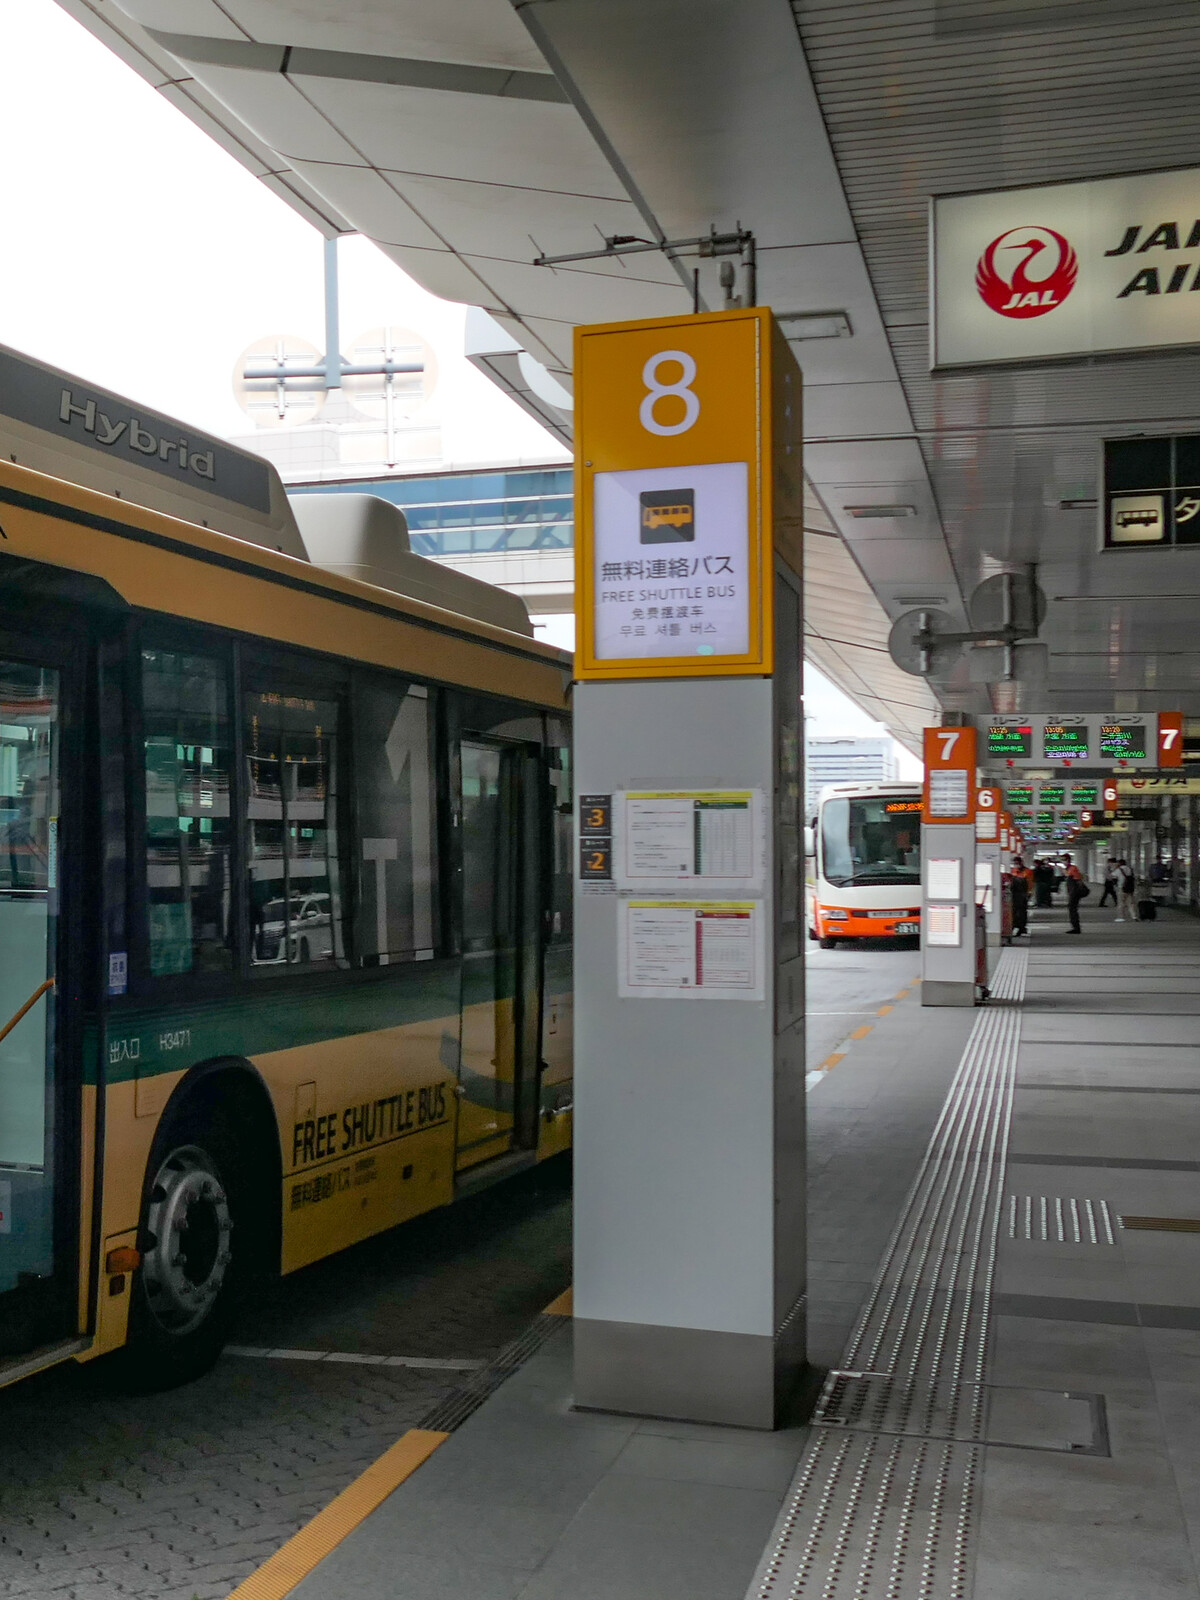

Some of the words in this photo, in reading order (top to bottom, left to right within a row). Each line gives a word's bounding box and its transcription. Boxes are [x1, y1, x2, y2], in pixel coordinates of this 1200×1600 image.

[1001, 289, 1059, 310] JAL
[638, 349, 701, 437] 8
[59, 388, 215, 481] Hybrid
[601, 555, 735, 582] 無料連絡バス
[602, 590, 635, 602] FREE
[640, 587, 702, 600] SHUTTLE
[707, 585, 736, 598] BUS
[619, 625, 647, 638] 무료
[689, 622, 717, 635] 버스
[937, 732, 960, 760] 7
[1160, 728, 1179, 750] 7
[978, 790, 994, 808] 6
[1104, 788, 1117, 801] 6
[1081, 811, 1091, 821] 5
[108, 1037, 140, 1064] 出入口
[159, 1029, 191, 1051] H3471
[291, 1113, 338, 1168] FREE
[341, 1090, 415, 1151] SHUTTLE
[418, 1081, 447, 1126] BUS
